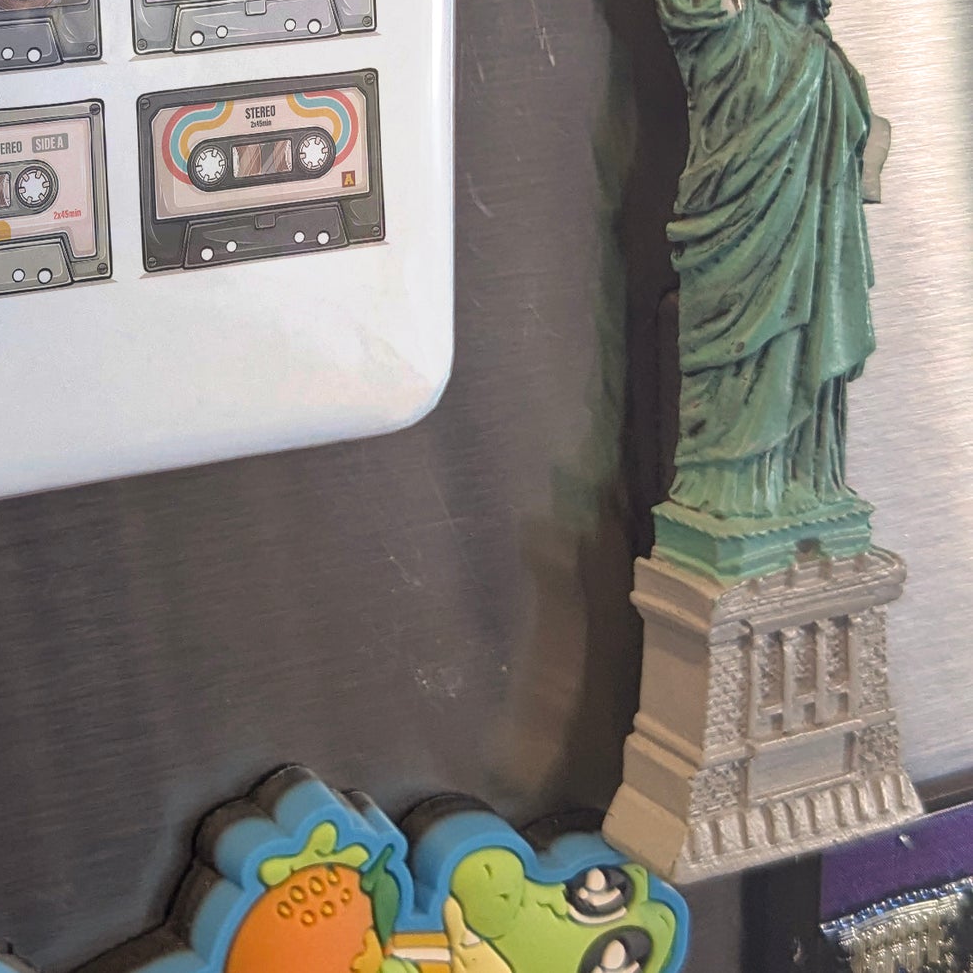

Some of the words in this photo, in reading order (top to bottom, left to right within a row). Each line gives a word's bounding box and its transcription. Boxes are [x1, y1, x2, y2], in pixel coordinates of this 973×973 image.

[245, 105, 276, 120] STEREO
[35, 136, 55, 151] SIDE
[56, 135, 64, 148] A
[344, 174, 354, 186] A
[53, 209, 82, 219] 2x45min
